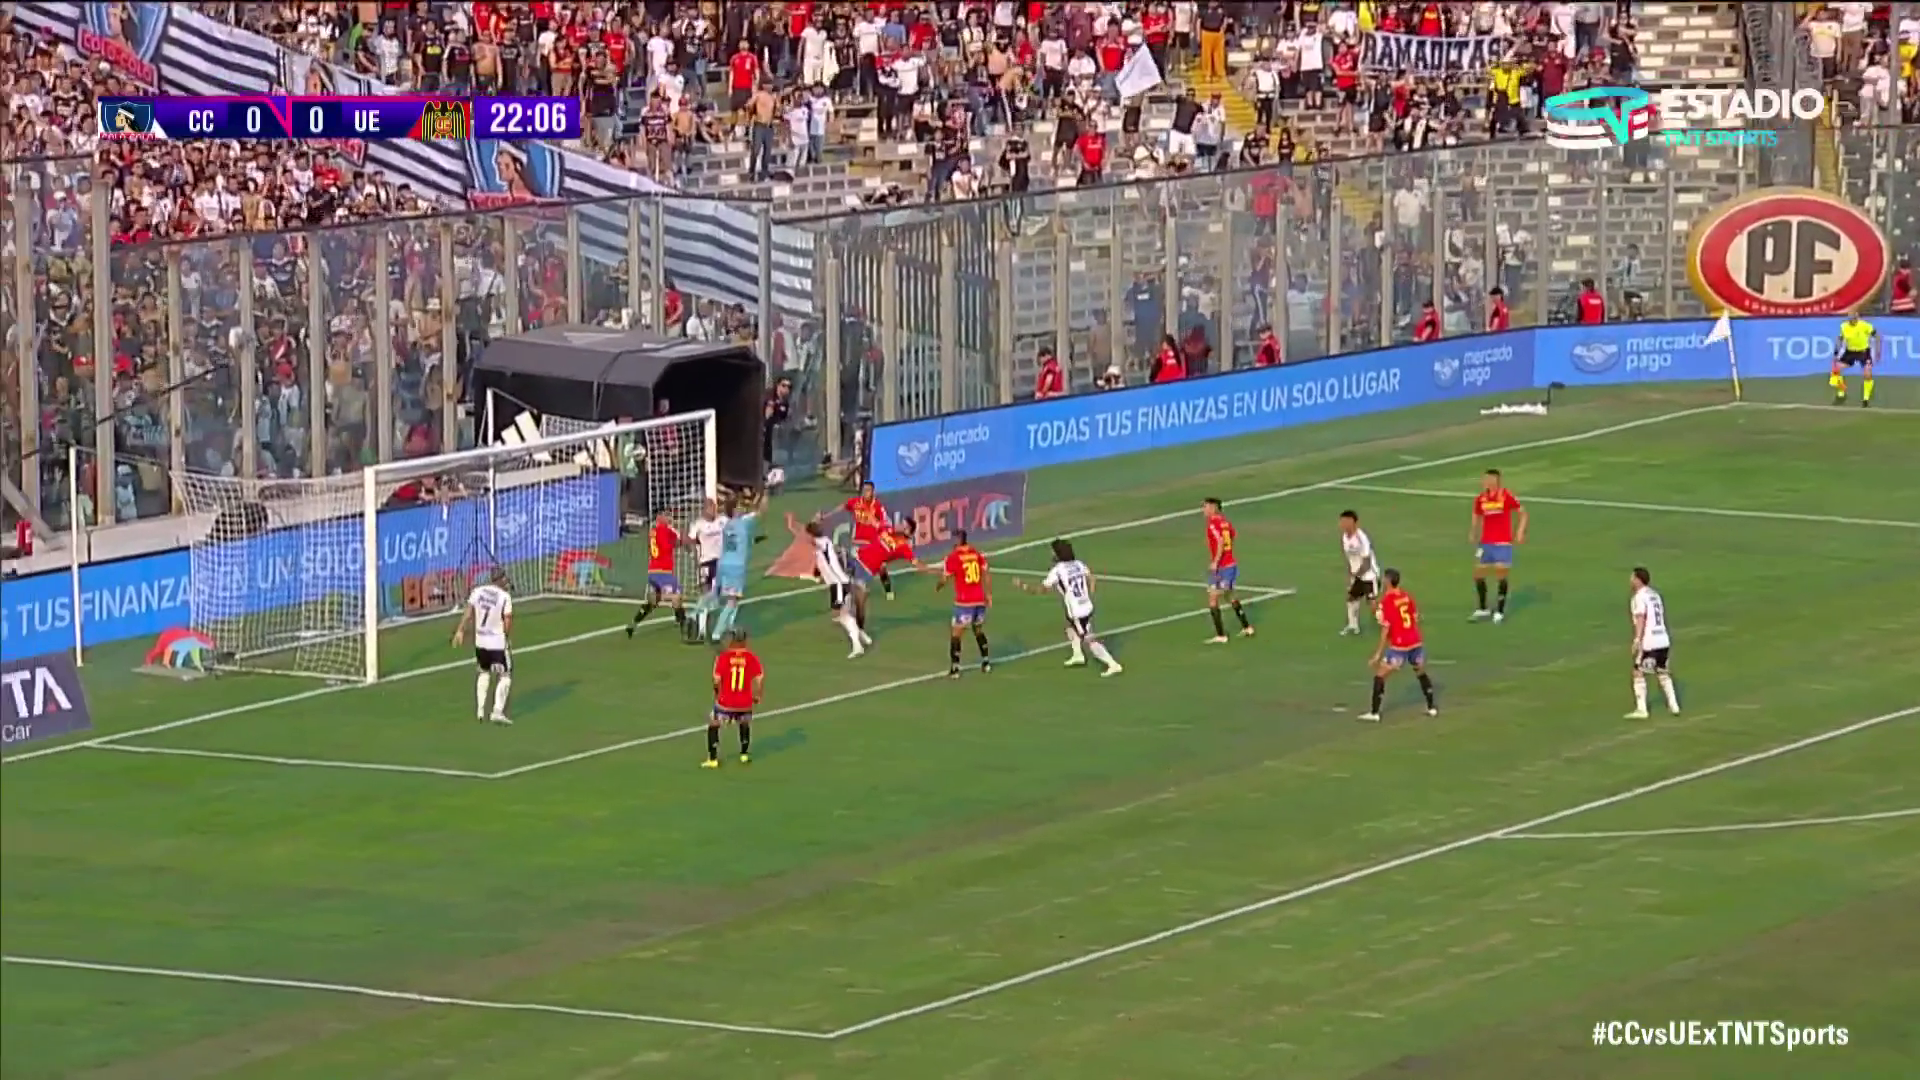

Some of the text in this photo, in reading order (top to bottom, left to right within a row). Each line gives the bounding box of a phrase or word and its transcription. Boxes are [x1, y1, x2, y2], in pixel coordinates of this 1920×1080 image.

[1626, 332, 1708, 351] mercado
[1767, 336, 1833, 361] TOD
[1463, 345, 1513, 367] mercado
[1626, 352, 1672, 372] pago
[1463, 363, 1491, 386] pago
[1027, 367, 1401, 451] TODAS TUS FINANZAS EN UN SOLO LUGAR
[934, 424, 989, 449] mercado
[934, 447, 966, 472] pago
[17, 597, 71, 637] TUS
[258, 555, 294, 589] UN
[378, 526, 449, 565] UGAR
[962, 561, 980, 584] 30
[480, 603, 491, 627] 7
[1399, 604, 1411, 628] 5
[731, 665, 745, 692] 11
